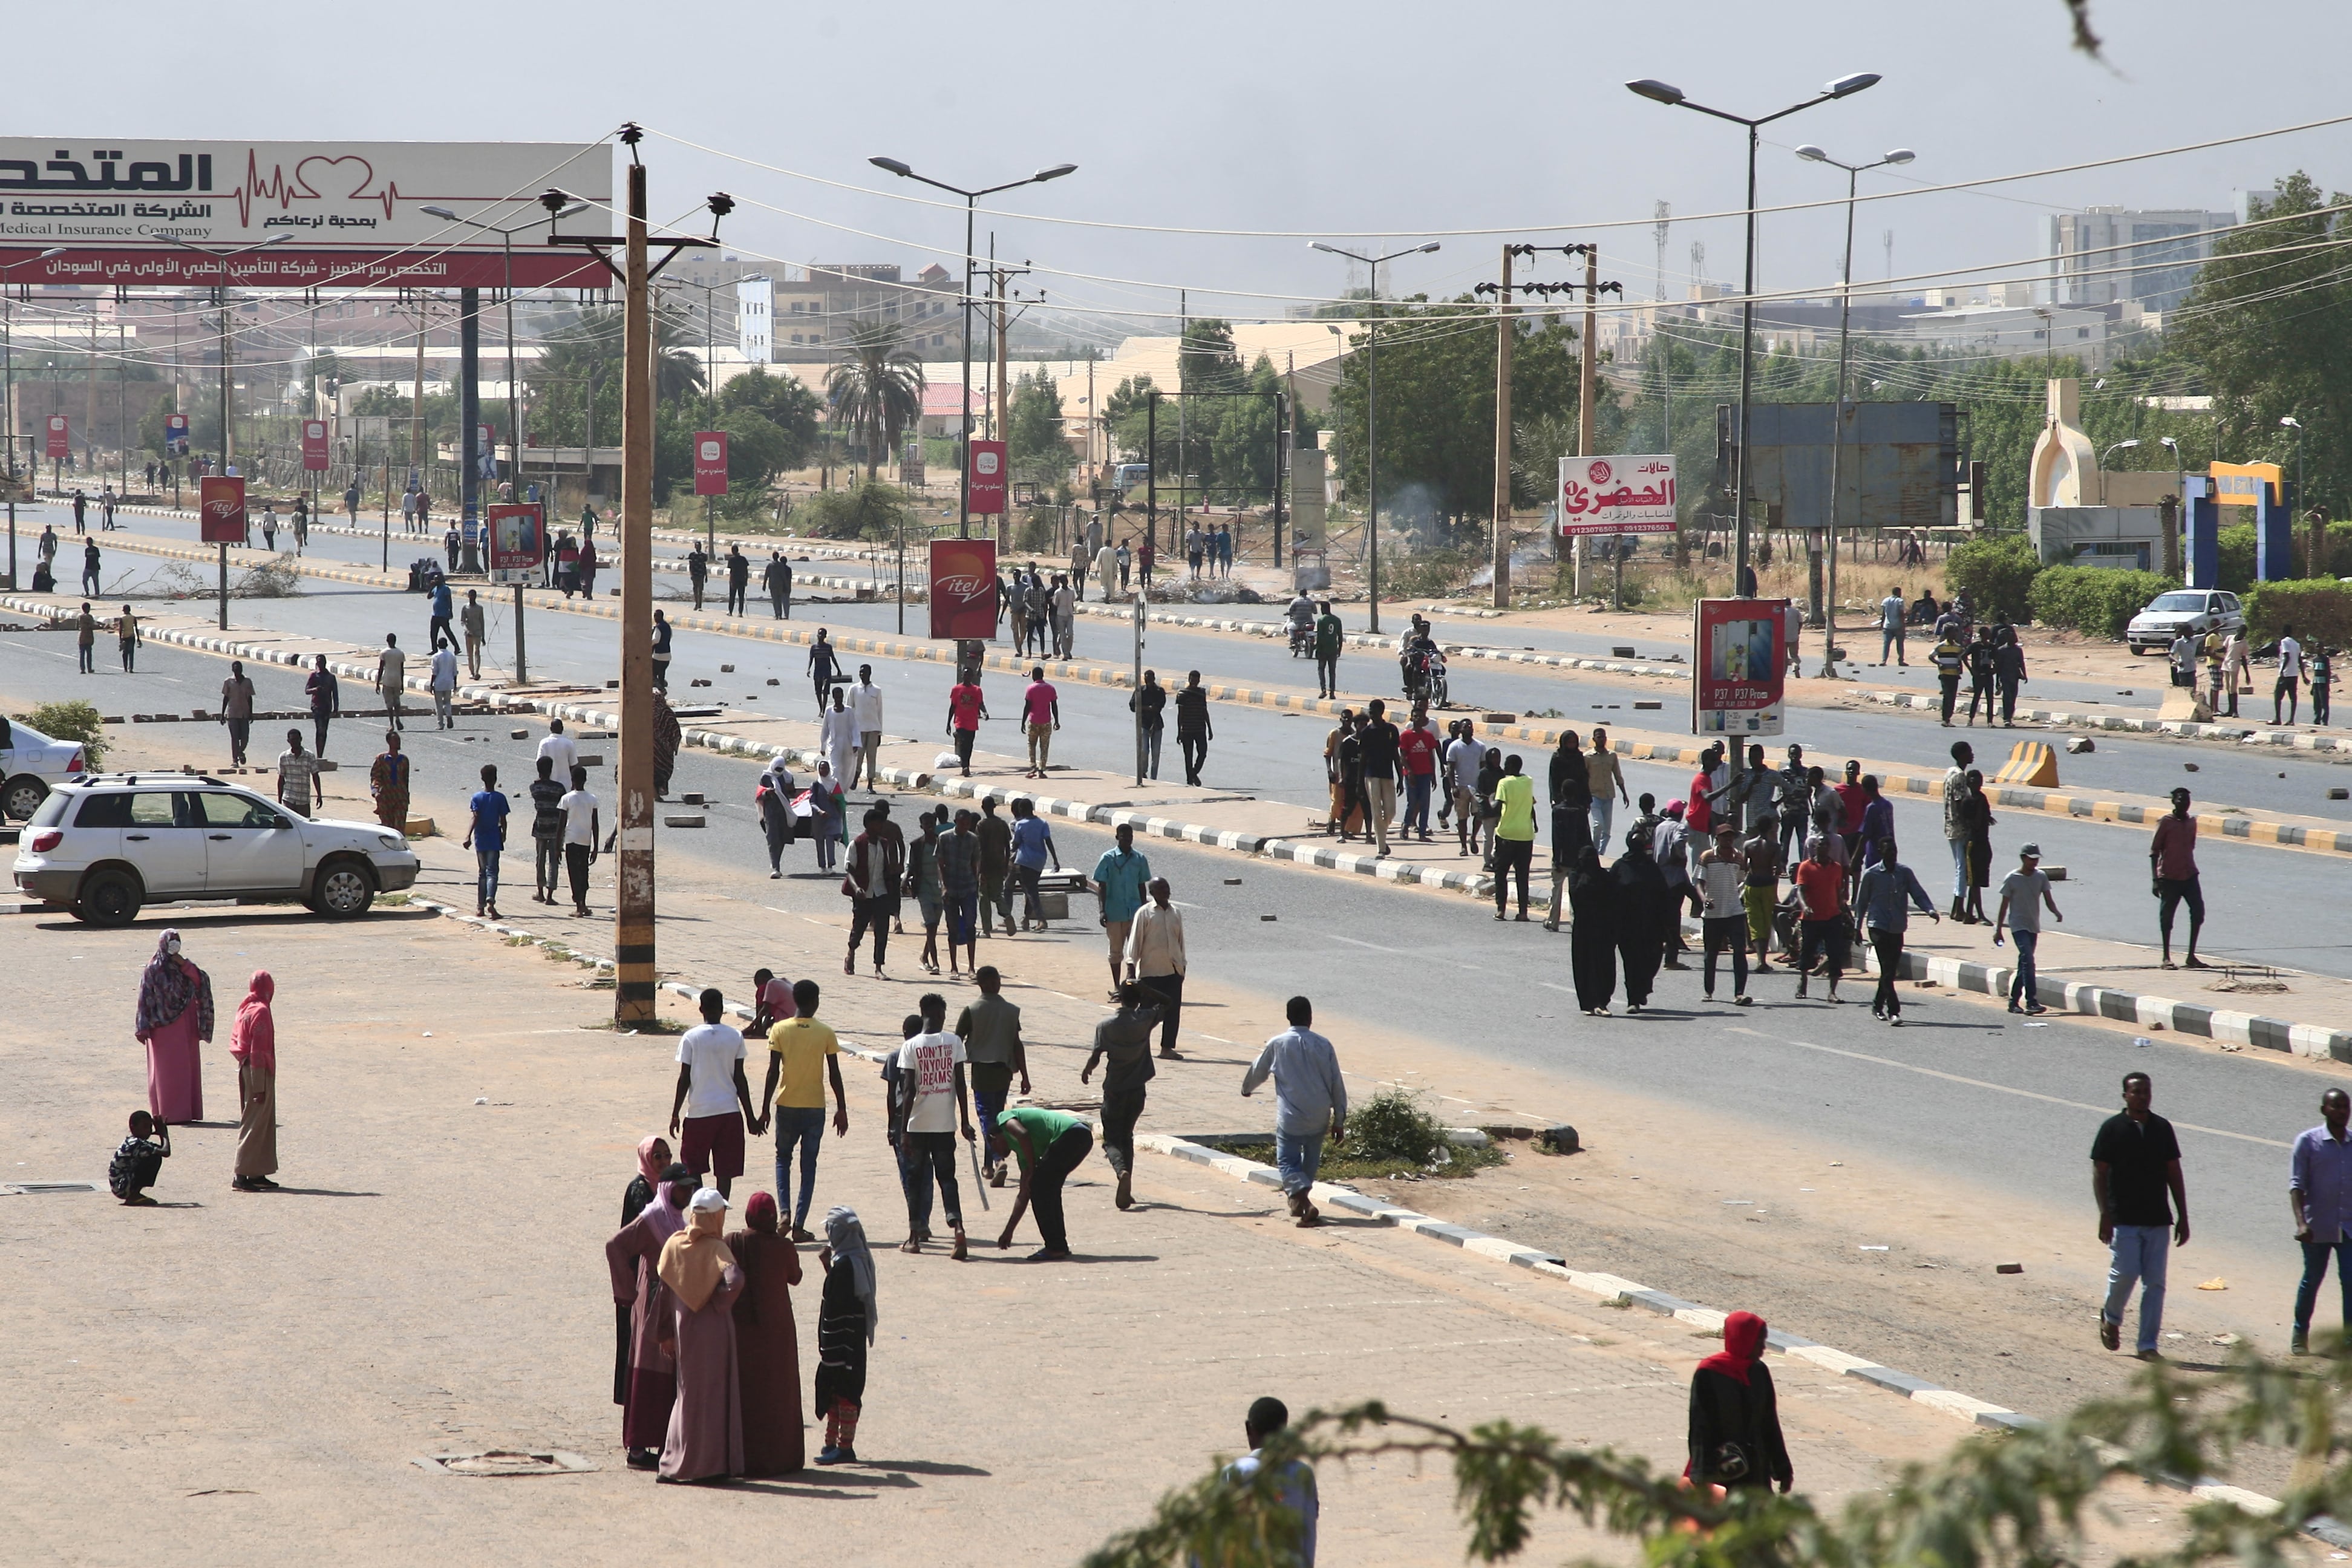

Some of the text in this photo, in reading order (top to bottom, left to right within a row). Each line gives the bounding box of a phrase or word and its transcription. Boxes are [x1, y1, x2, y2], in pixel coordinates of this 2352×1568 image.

[11, 201, 125, 217] المتخصصة
[133, 200, 211, 221] الشركة
[263, 215, 377, 229] بمحبة نرعاكم
[57, 223, 132, 235] Insurance
[138, 224, 212, 239] Company
[46, 260, 102, 275] السودان
[106, 260, 131, 278] في
[134, 258, 179, 276] الأولى
[230, 256, 277, 277] التأمين
[281, 260, 318, 277] شركة
[329, 261, 365, 277] التميز
[368, 266, 387, 278] سر
[390, 263, 447, 278] التخصص
[1637, 462, 1670, 474] صالات
[212, 502, 234, 512] itel
[1566, 479, 1675, 522] الحضري
[1571, 525, 1618, 534] 0123076503
[948, 578, 980, 592] itel
[1328, 623, 1334, 635] 9
[1714, 688, 1728, 699] P37
[1735, 688, 1748, 699] P37
[915, 1045, 943, 1059] DON'T
[919, 1057, 953, 1073] ON YOUR
